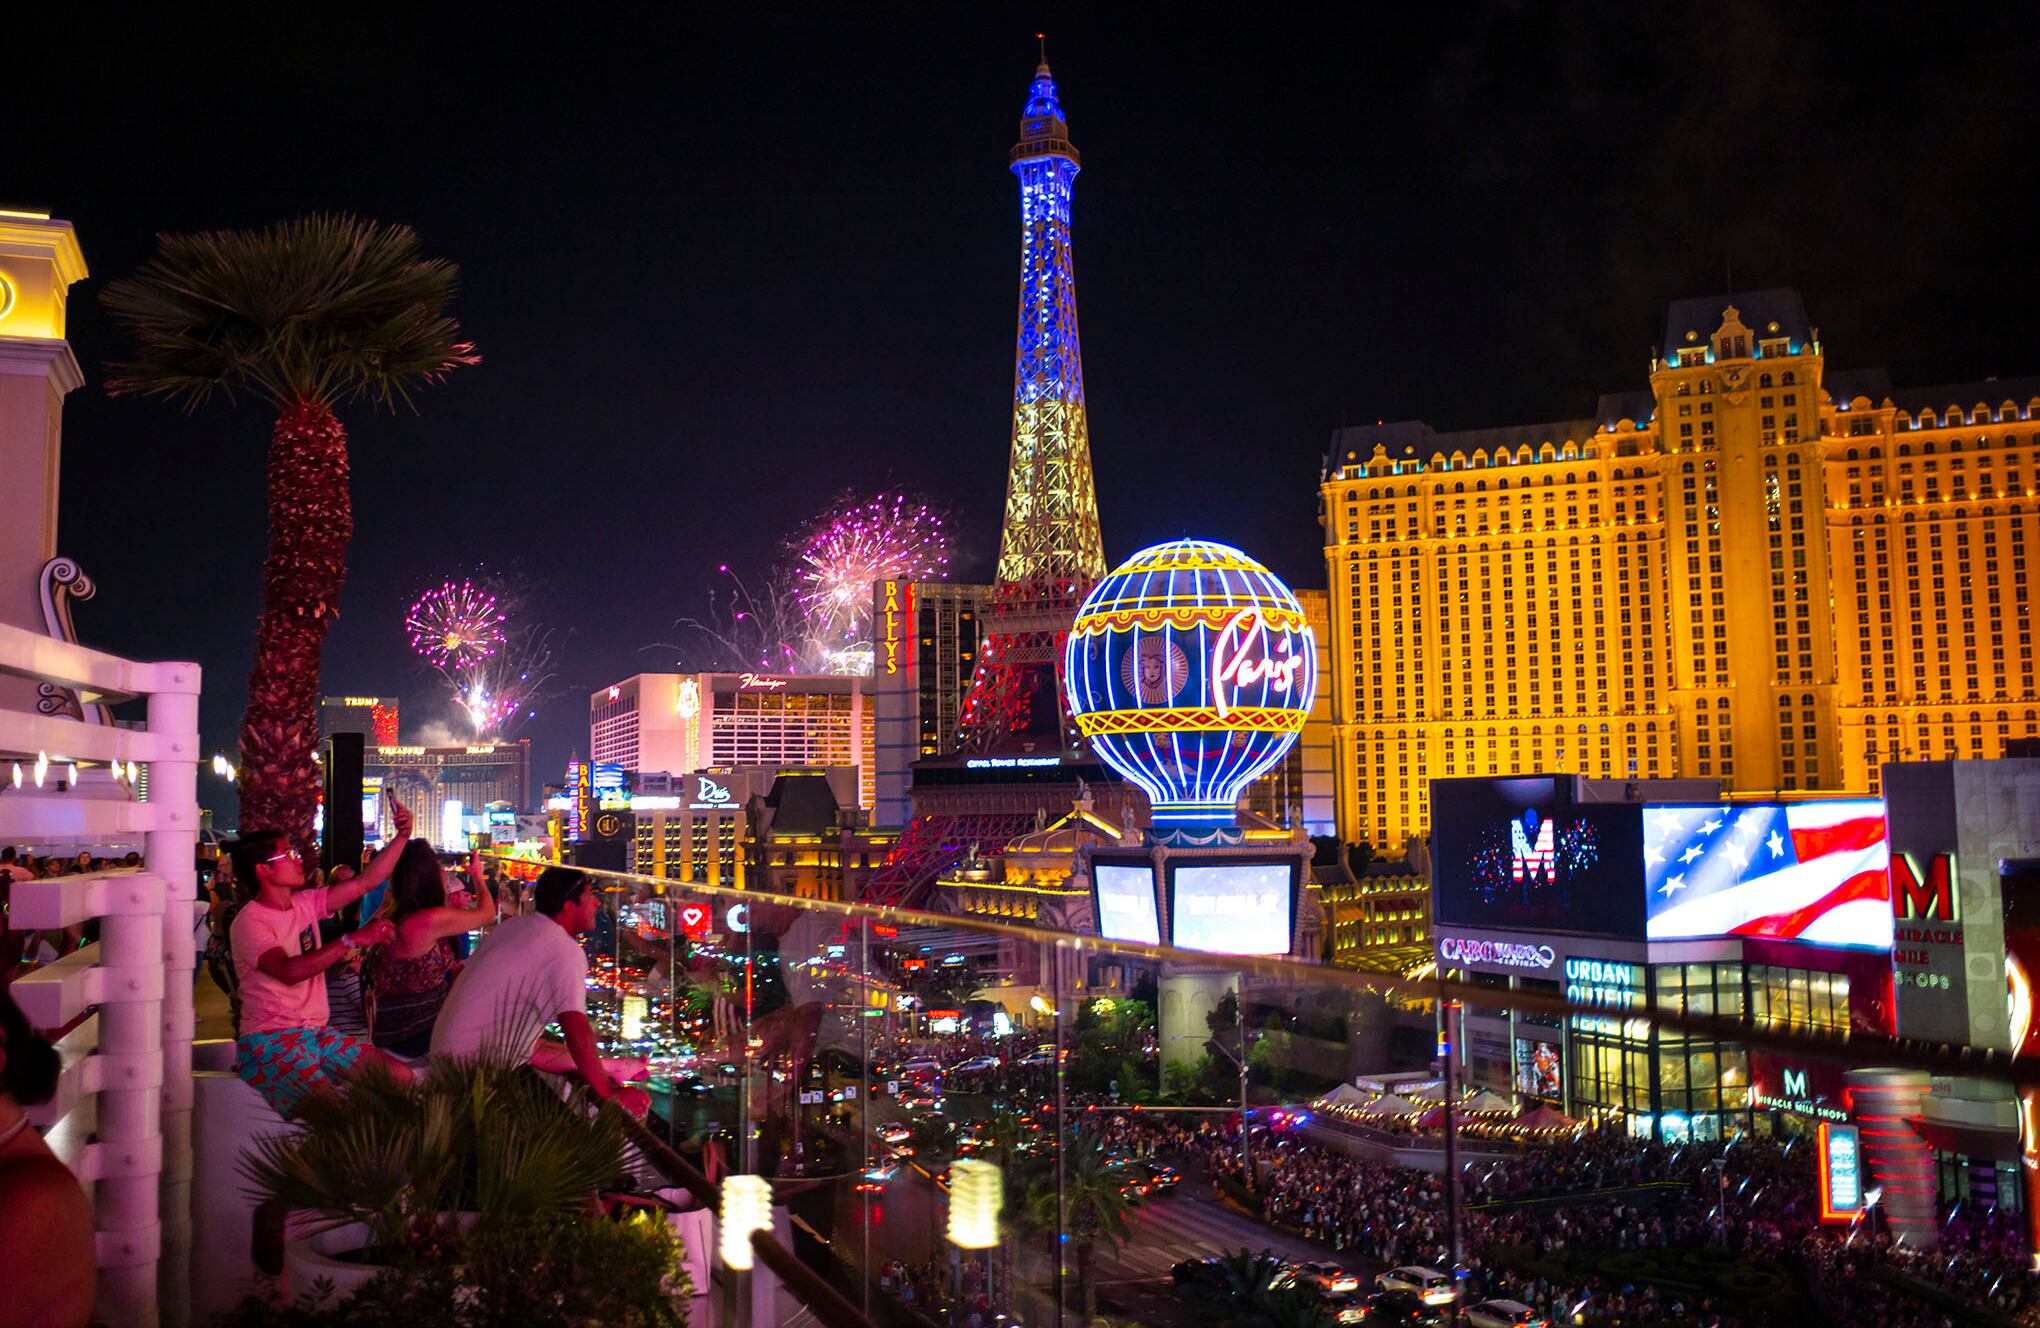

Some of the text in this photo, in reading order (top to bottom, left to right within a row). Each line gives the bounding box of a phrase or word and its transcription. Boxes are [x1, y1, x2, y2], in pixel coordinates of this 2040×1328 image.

[883, 581, 899, 675] BALLYS
[1212, 606, 1302, 718] Paris
[738, 673, 786, 690] Flamingo
[345, 697, 379, 706] TRUMP
[1511, 818, 1556, 883] M
[1891, 852, 1958, 921] M
[1893, 928, 1964, 945] MIRACLE
[1440, 938, 1546, 964] CABO WABO
[1894, 950, 1930, 965] MILE
[1566, 960, 1631, 985] URBAN
[1894, 970, 1949, 990] SHOPS
[1783, 1068, 1806, 1098] M
[1758, 1095, 1848, 1121] MIRACLE MILE SHOPS
